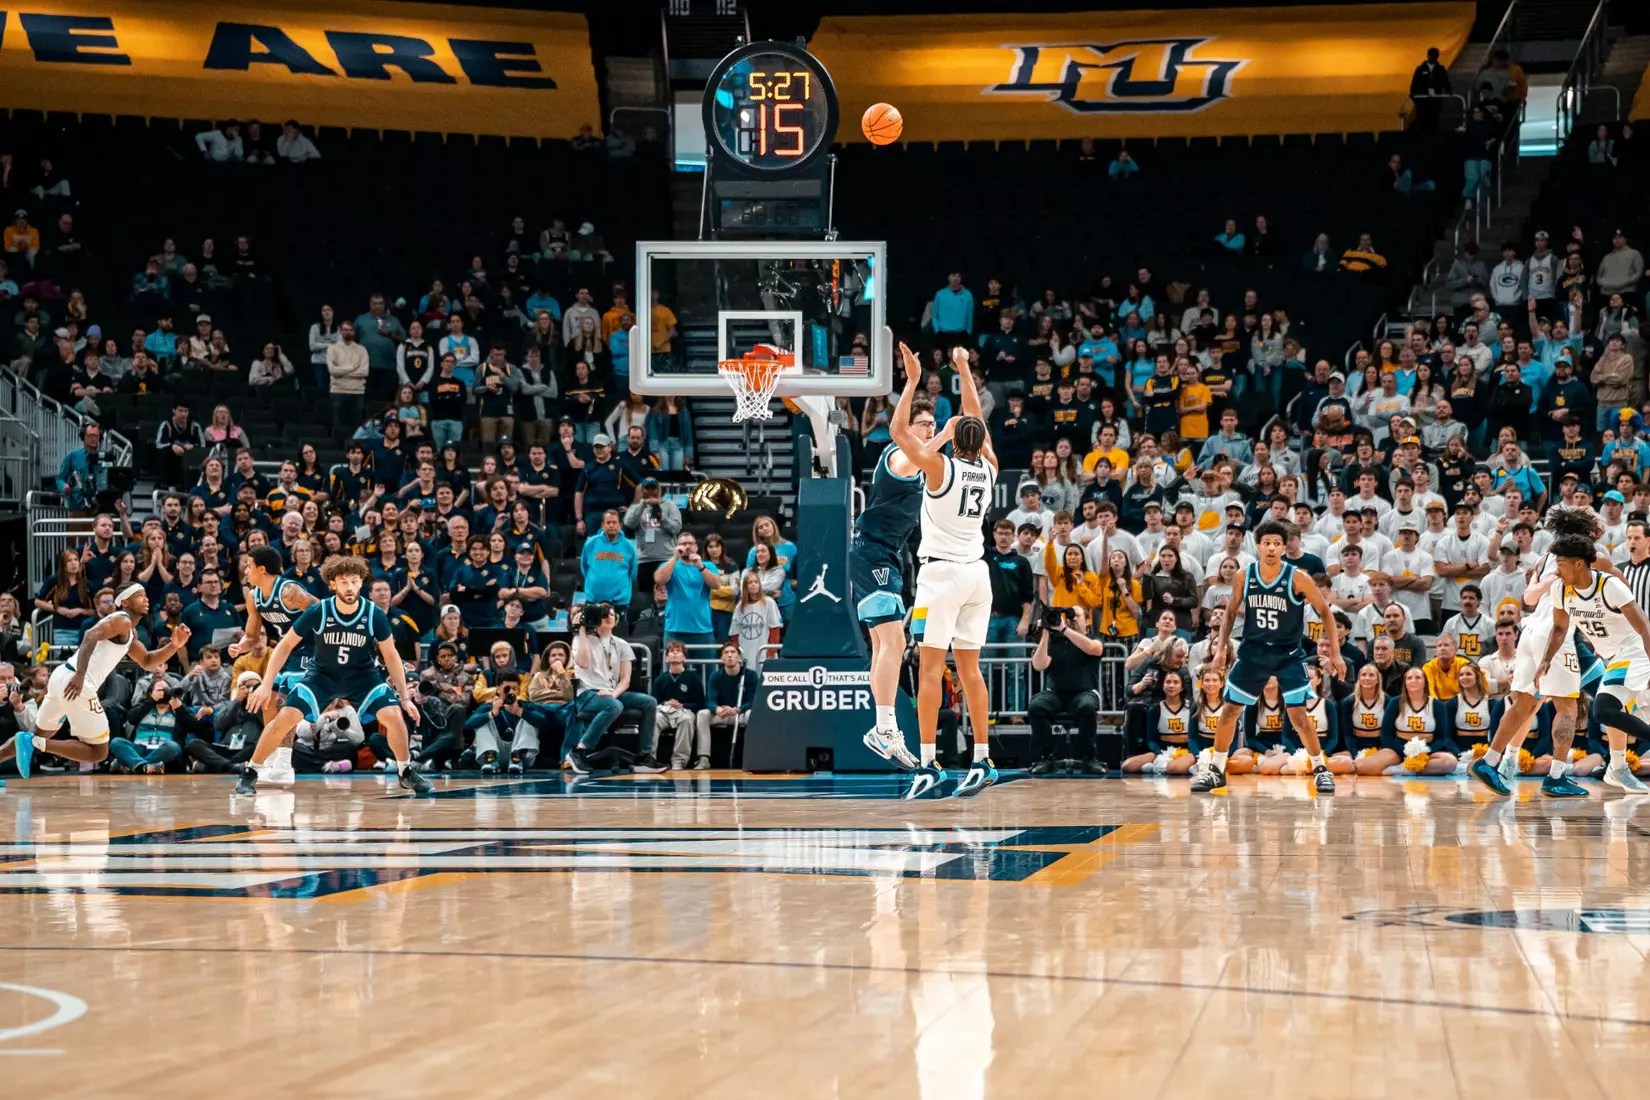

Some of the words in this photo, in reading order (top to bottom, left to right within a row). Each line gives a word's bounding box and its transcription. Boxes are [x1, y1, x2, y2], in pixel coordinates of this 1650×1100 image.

[0, 11, 131, 66] E
[203, 21, 558, 90] ARE
[749, 72, 811, 100] 5:27
[759, 103, 804, 156] 15
[961, 471, 987, 483] PARHAM
[957, 484, 986, 519] 13
[871, 567, 890, 586] V
[1248, 594, 1288, 613] VILLANOVA
[1568, 606, 1606, 619] Marquette
[1256, 608, 1279, 631] 55
[1577, 621, 1610, 639] 35
[1459, 632, 1483, 656] MU
[337, 646, 351, 665] 5
[767, 675, 786, 683] ONE
[829, 674, 856, 682] THAT'S
[766, 689, 871, 711] GRUBER
[1168, 717, 1185, 733] MU
[1361, 713, 1378, 728] MU
[1408, 716, 1425, 732] MU
[1465, 712, 1482, 727] MU
